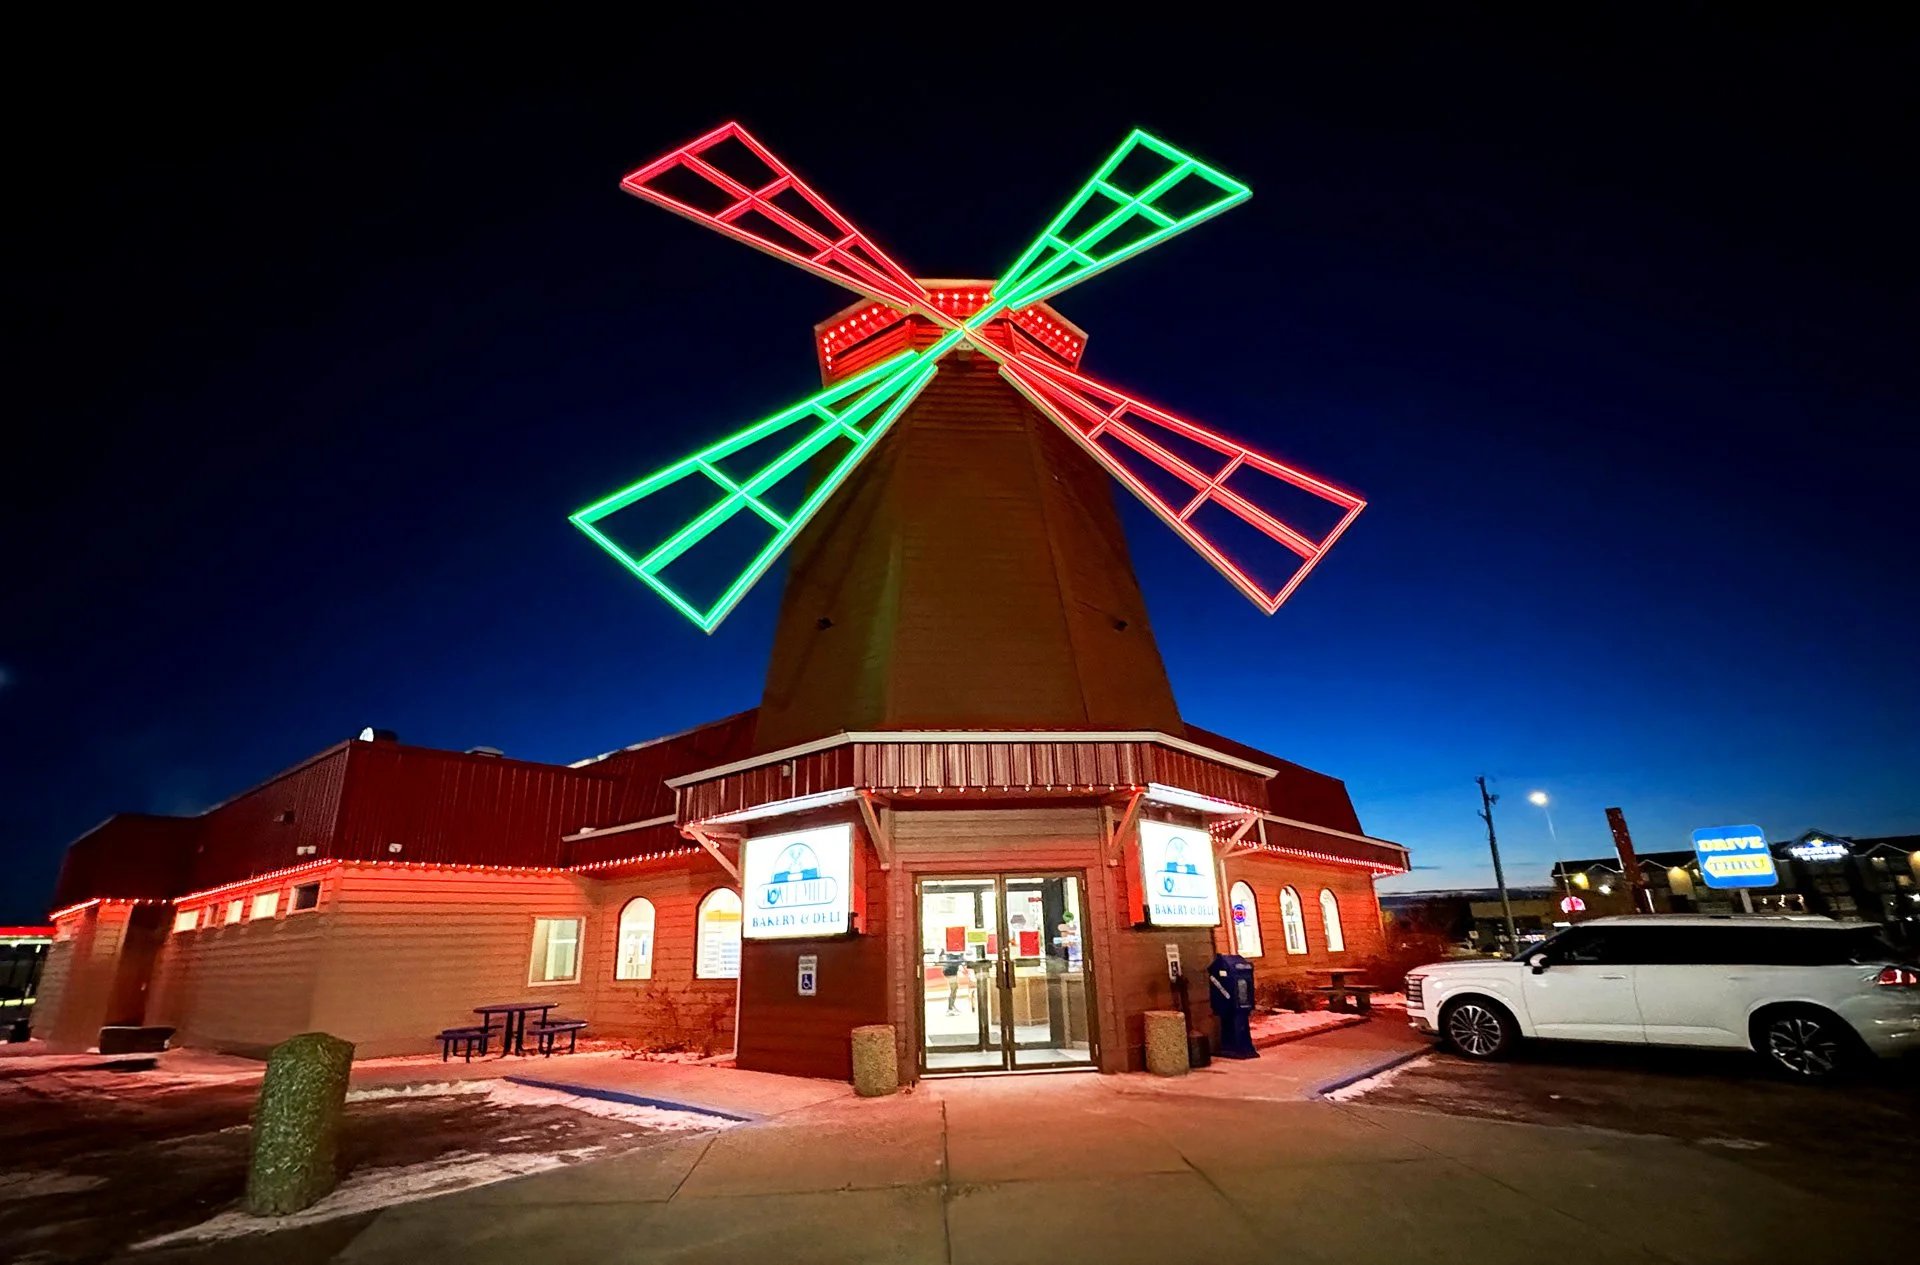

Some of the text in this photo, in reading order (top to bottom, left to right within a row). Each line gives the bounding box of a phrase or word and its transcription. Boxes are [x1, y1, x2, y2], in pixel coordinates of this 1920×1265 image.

[1697, 836, 1765, 852] DRIVE
[1709, 859, 1765, 871] THRU
[1155, 904, 1188, 916] BAKERY
[1198, 904, 1214, 916] DELI
[752, 911, 841, 928] BAKERY & DELI
